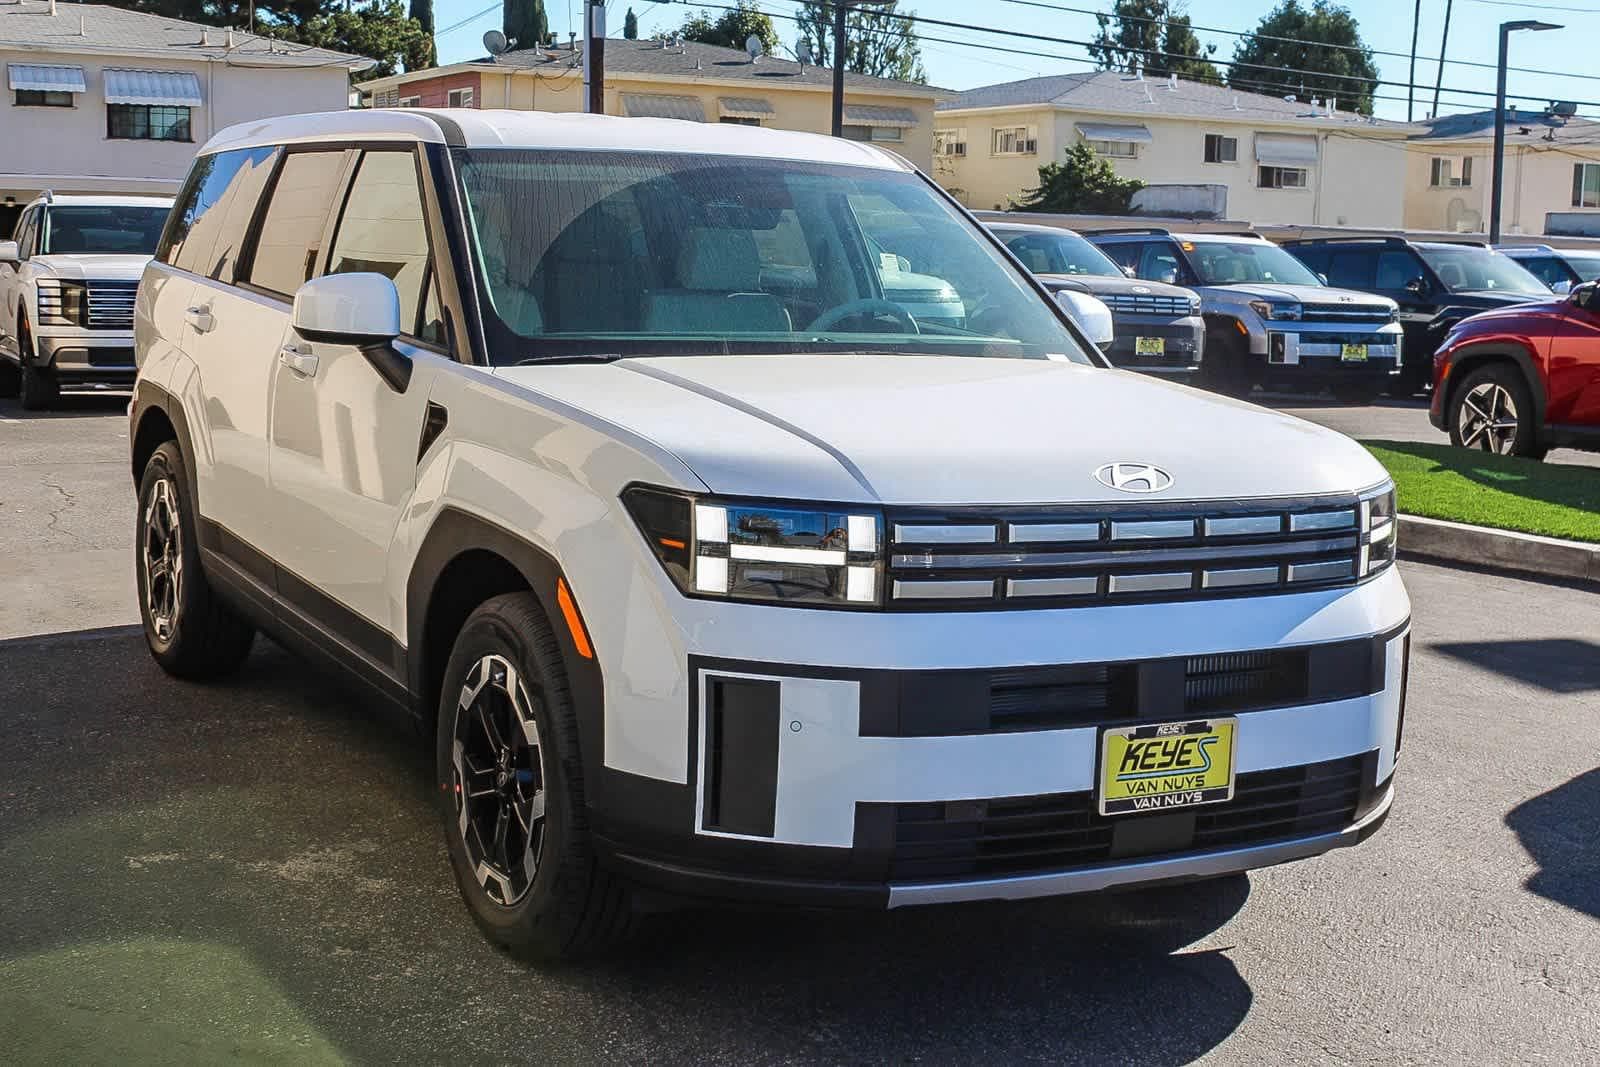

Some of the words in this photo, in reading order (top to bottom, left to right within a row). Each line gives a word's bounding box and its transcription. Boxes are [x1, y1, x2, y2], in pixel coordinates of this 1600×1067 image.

[1119, 736, 1219, 773] KEYES
[1126, 779, 1158, 794] VAN
[1163, 775, 1205, 791] NUYS
[1133, 795, 1161, 809] VAN
[1164, 791, 1203, 806] NUYS
